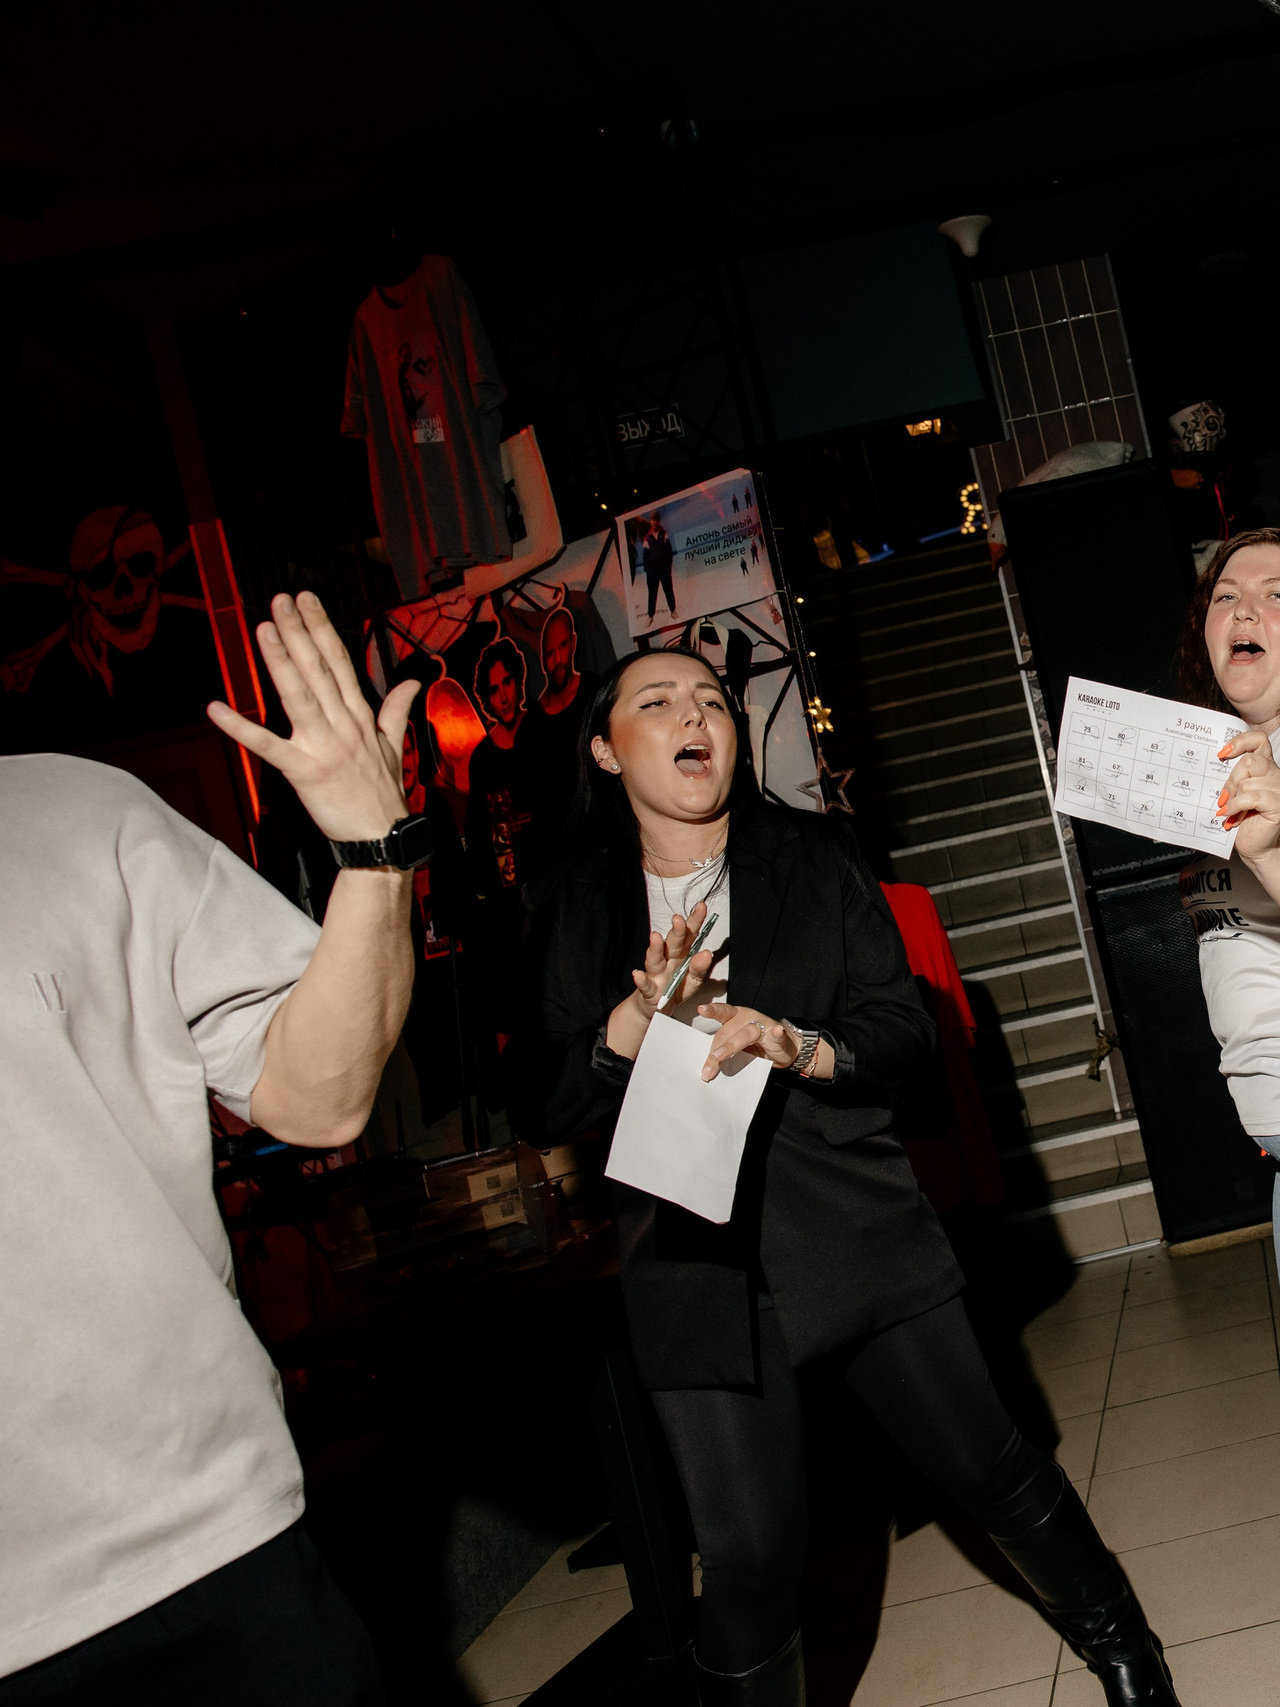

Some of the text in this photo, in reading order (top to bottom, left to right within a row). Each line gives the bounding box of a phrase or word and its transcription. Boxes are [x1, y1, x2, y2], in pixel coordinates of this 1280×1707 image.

[685, 516, 753, 547] Антонь самый
[684, 529, 758, 561] лучший диджей
[704, 546, 747, 567] на свете
[1077, 693, 1105, 707] KARAOKE
[1105, 700, 1121, 711] LOTO
[1176, 717, 1212, 736] 3 раунд
[1150, 742, 1159, 750] 63
[1181, 779, 1190, 787] 83
[1108, 793, 1116, 801] 71
[1140, 803, 1149, 811] 76
[1176, 810, 1184, 818] 78
[1210, 818, 1219, 826] 65
